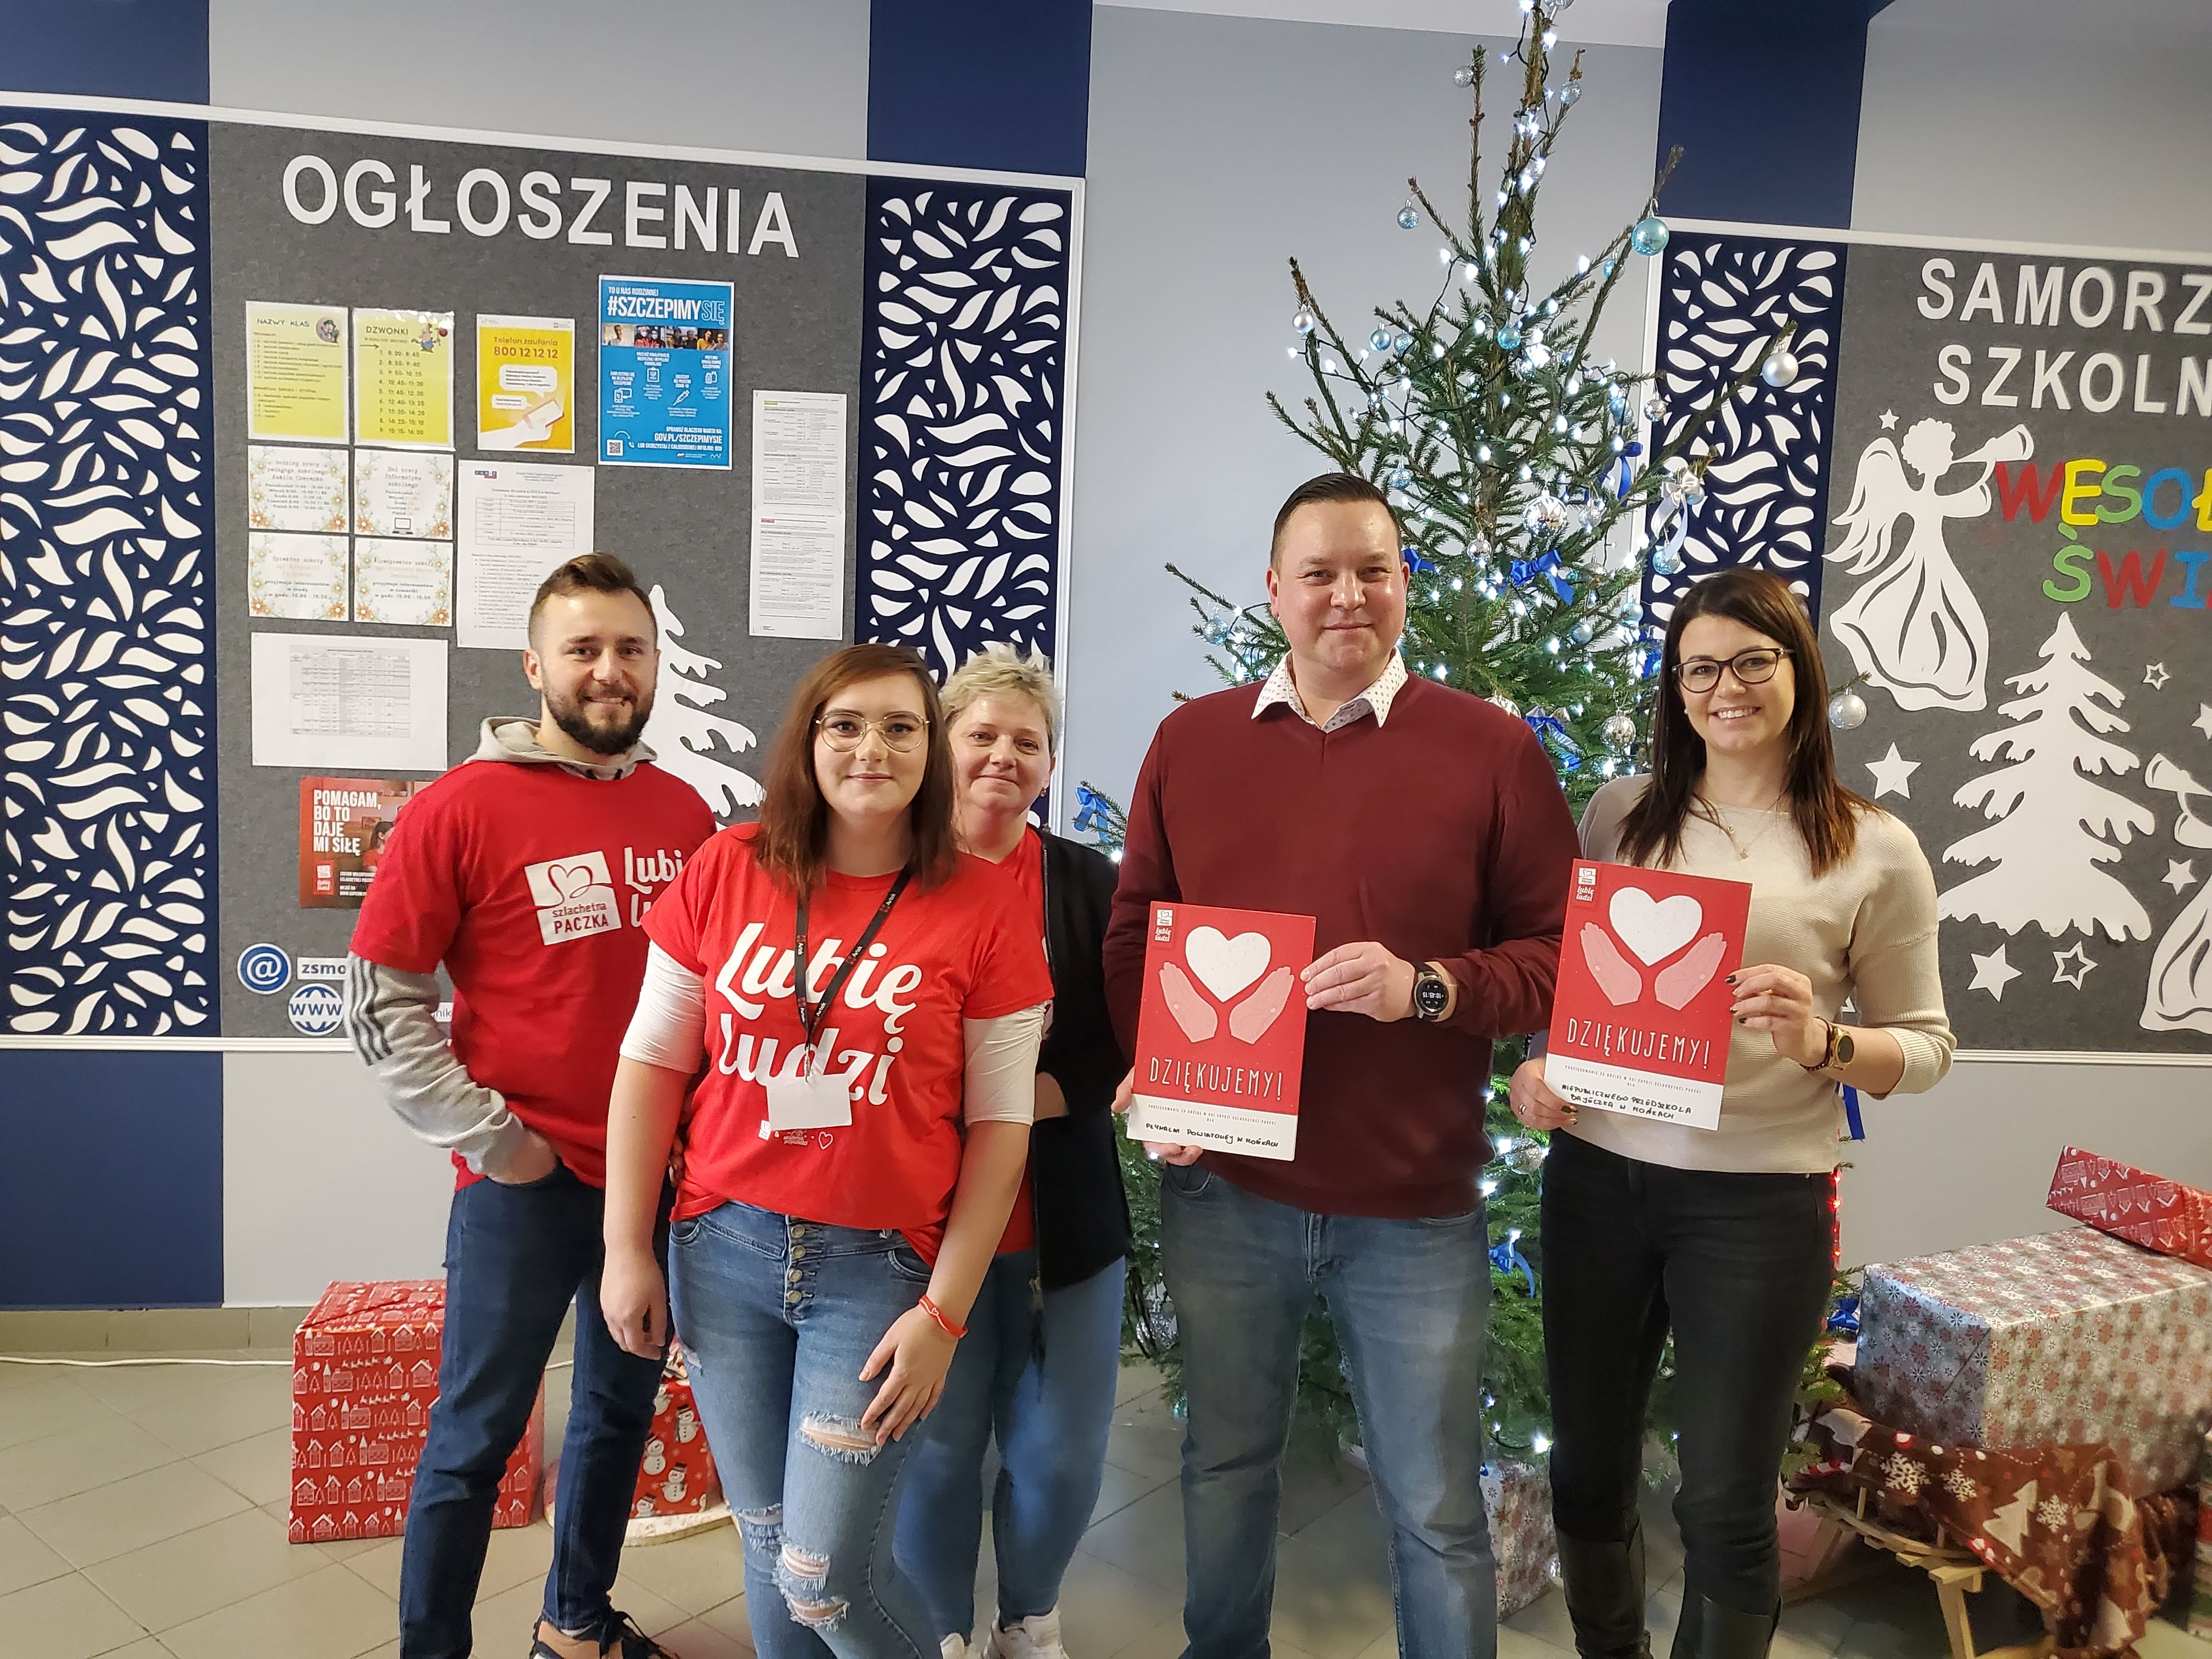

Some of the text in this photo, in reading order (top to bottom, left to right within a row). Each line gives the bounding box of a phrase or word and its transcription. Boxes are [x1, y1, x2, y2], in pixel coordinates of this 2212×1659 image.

[283, 155, 799, 258] OGŁOSZENIA
[1917, 258, 2212, 335] SAMORZ
[366, 326, 408, 335] DZWONKI
[494, 346, 558, 358] 800 12 12 12
[1933, 345, 2212, 417] SZKOLN
[654, 432, 723, 444] GOV.PL/SZCZEPIMYSIE
[2042, 523, 2212, 610] ŚWI
[313, 789, 381, 810] POMAGAM,
[313, 805, 350, 822] BO TO
[313, 821, 345, 837] DAJE
[313, 836, 361, 856] MI SIŁĘ
[552, 902, 607, 918] szlachetna
[553, 913, 609, 934] PACZKA
[715, 923, 922, 1035] Lubię
[1567, 1018, 1710, 1069] DZIĘKUJEMY!
[718, 1013, 904, 1105] ludzi
[1150, 1057, 1282, 1101] DZIĘKUJEMY!
[1562, 1084, 1692, 1114] NIEPUBLICZNEGO PRZEDSZKOLA
[1570, 1093, 1613, 1108] BAJECZKA
[1633, 1105, 1674, 1119] MOŃKACH
[1187, 1128, 1234, 1144] POWIATOWEJ
